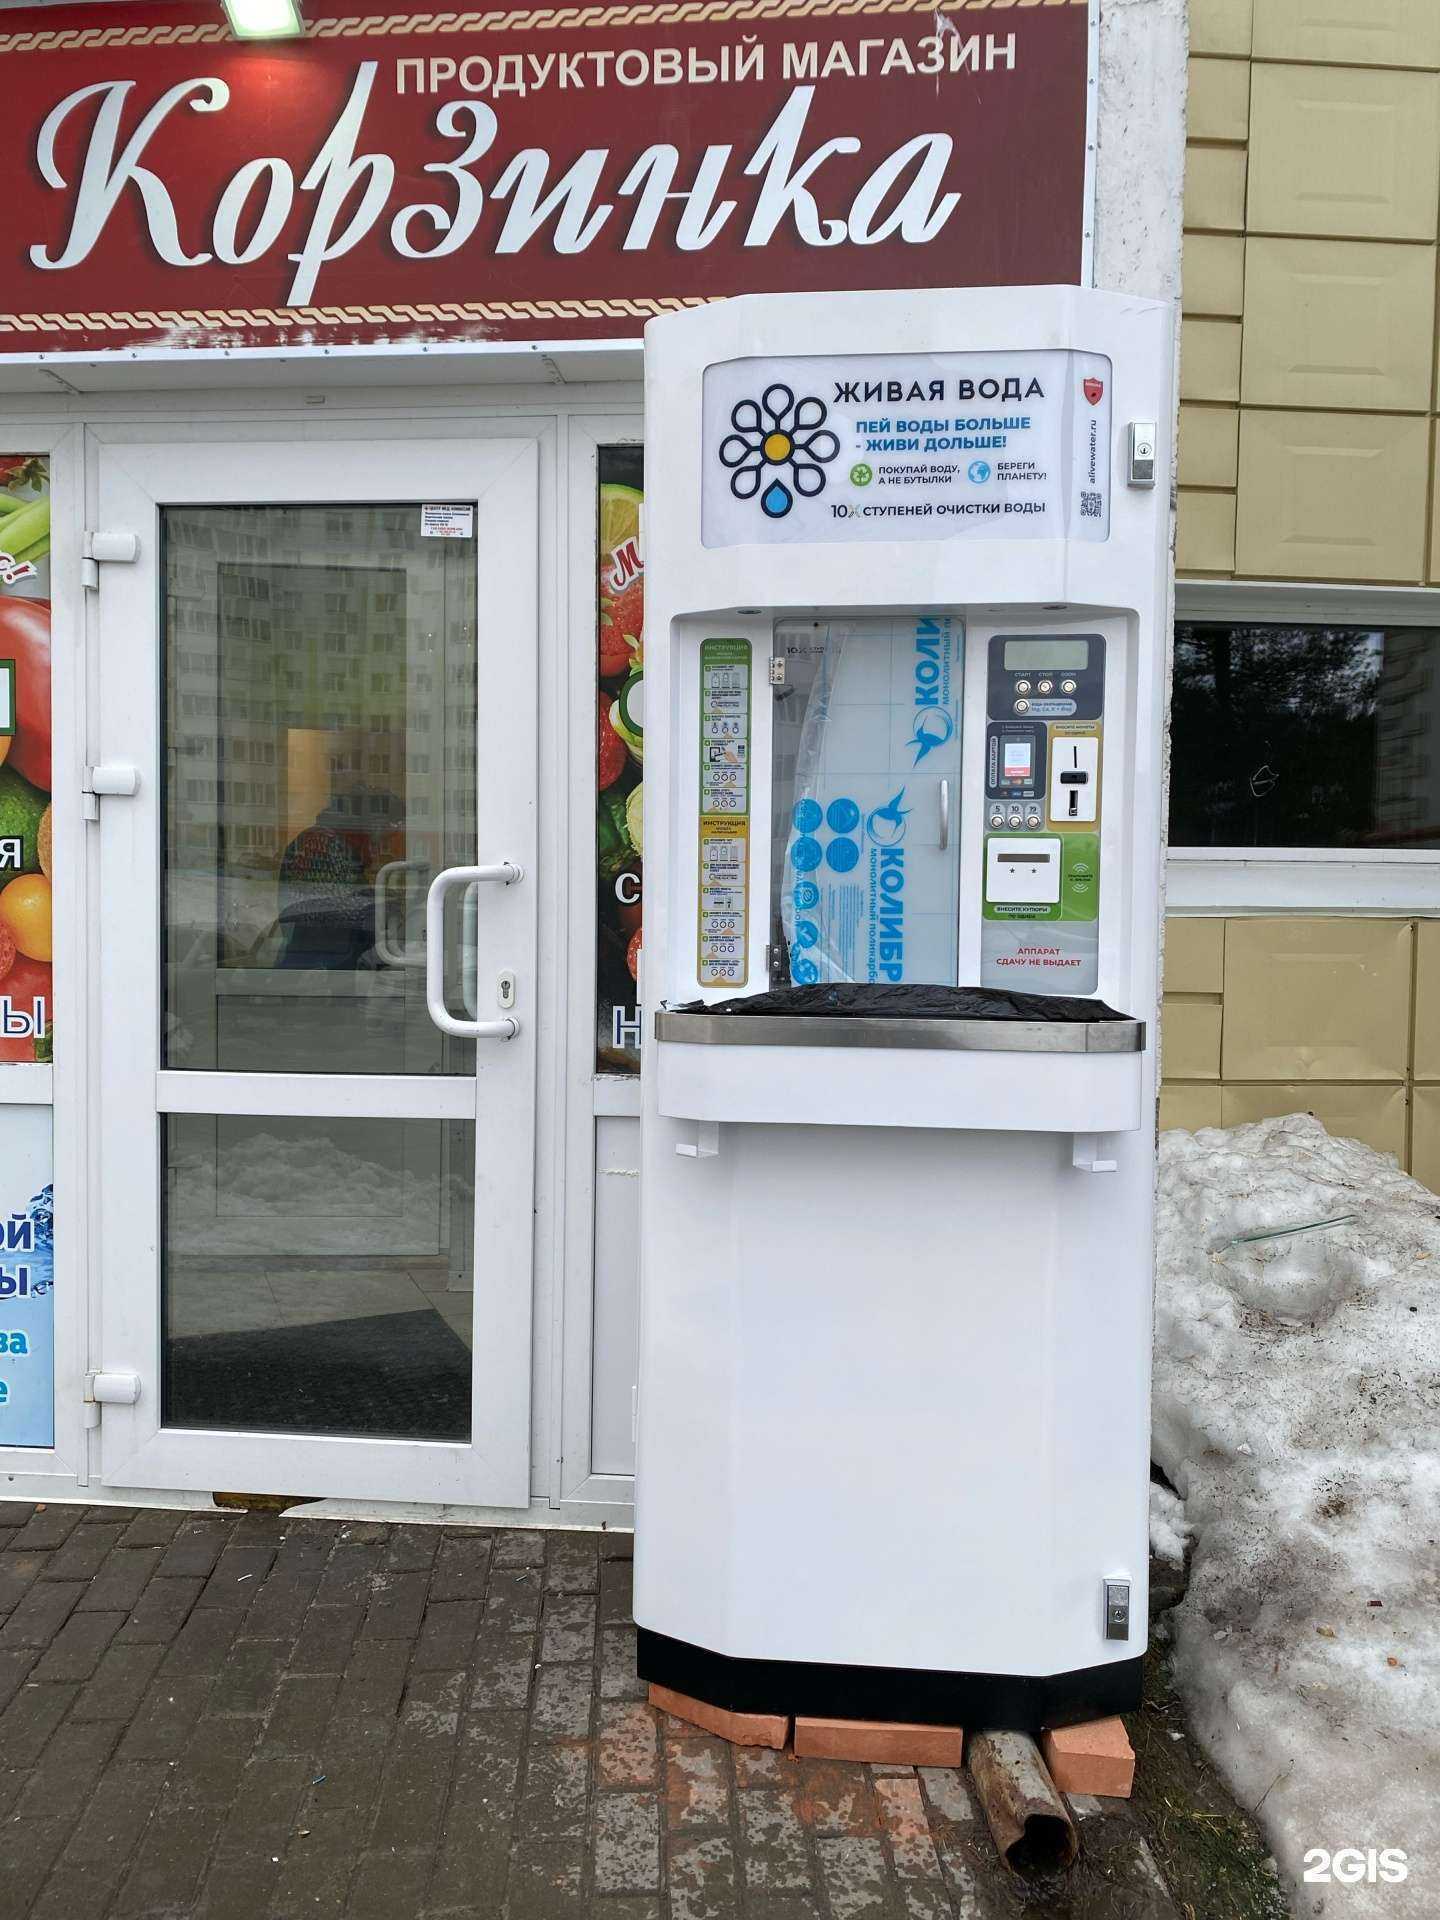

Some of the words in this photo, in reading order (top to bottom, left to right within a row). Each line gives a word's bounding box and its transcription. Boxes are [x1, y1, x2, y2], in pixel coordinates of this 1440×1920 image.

[396, 36, 765, 98] ПРОДУКТОВЫЙ
[781, 33, 1017, 78] МАГАЗИН
[29, 60, 962, 307] Корзинка
[833, 380, 945, 403] ЖИВАЯ
[959, 377, 1045, 402] ВОДА
[856, 417, 891, 434] ПЕЙ
[896, 419, 949, 434] ВОДЫ
[954, 416, 1031, 432] БОЛЬШЕ
[866, 438, 919, 451] ЖИВИ
[924, 435, 1007, 452] ДОЛЬШЕ!
[1088, 420, 1097, 484] alivewater.ru
[878, 464, 928, 475] ПОКУПАЙ
[930, 464, 961, 475] ВОДУ,
[997, 462, 1036, 471] БЕРЕГИ
[878, 477, 886, 485] А
[890, 476, 902, 485] НЕ
[904, 475, 952, 485] БУТЫЛКИ
[997, 472, 1047, 481] ПЛАНЕТУ!
[863, 503, 933, 517] СТУПЕНЕЙ
[936, 503, 1001, 515] ОЧИСТКИ
[1004, 502, 1046, 514] ВОДЫ
[995, 805, 1001, 813] 5
[1011, 805, 1020, 813] 10
[1017, 948, 1061, 956] АППАРАТ
[996, 958, 1027, 966] СДАЧУ
[1043, 959, 1082, 967] ВЫДАЕТ
